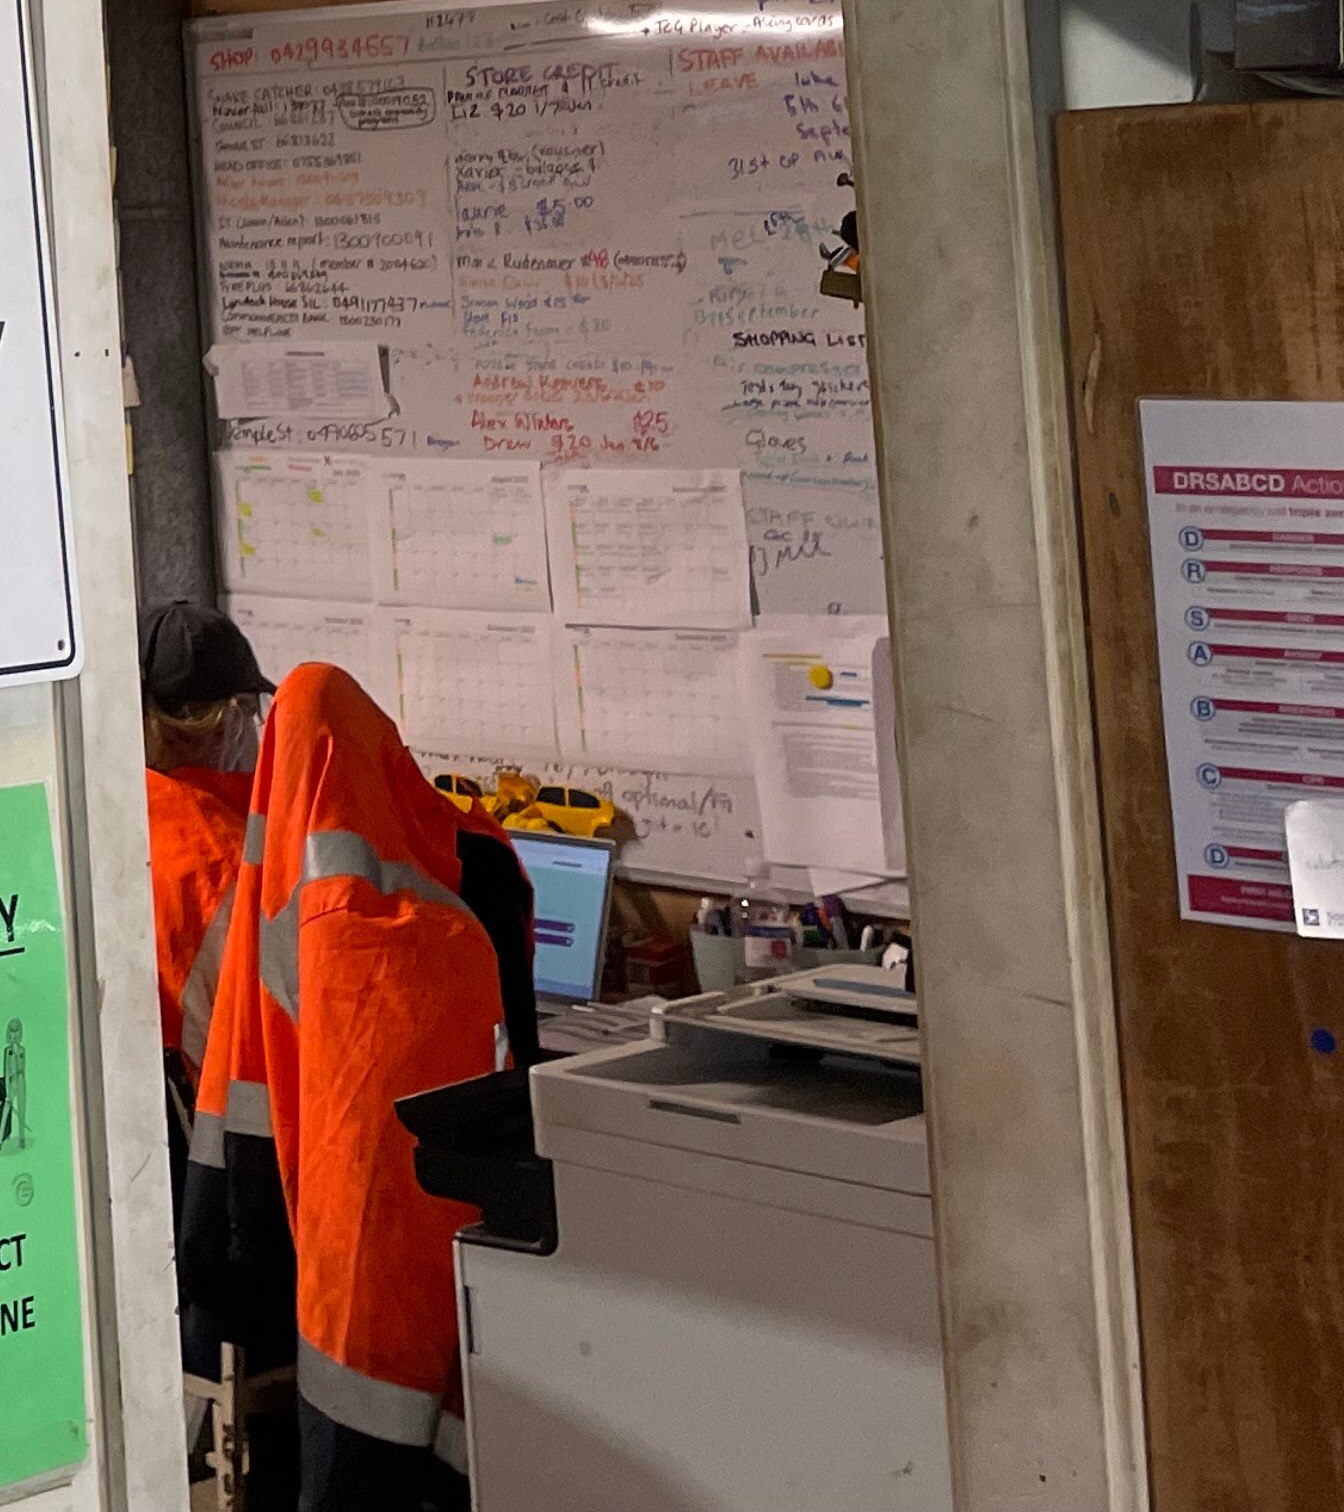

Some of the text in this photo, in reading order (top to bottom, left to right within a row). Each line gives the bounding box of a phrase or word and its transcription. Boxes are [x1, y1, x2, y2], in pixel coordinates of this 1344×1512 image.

[676, 47, 743, 72] STAFF
[464, 63, 533, 88] STORE
[731, 330, 817, 348] SHOPPING
[1173, 471, 1286, 492] DRSABCD
[1184, 531, 1201, 547] D
[1186, 563, 1203, 580] R
[1189, 610, 1205, 627] S
[1193, 645, 1209, 661] A
[1196, 700, 1212, 717] B
[1201, 767, 1218, 785] C
[1210, 847, 1226, 865] D
